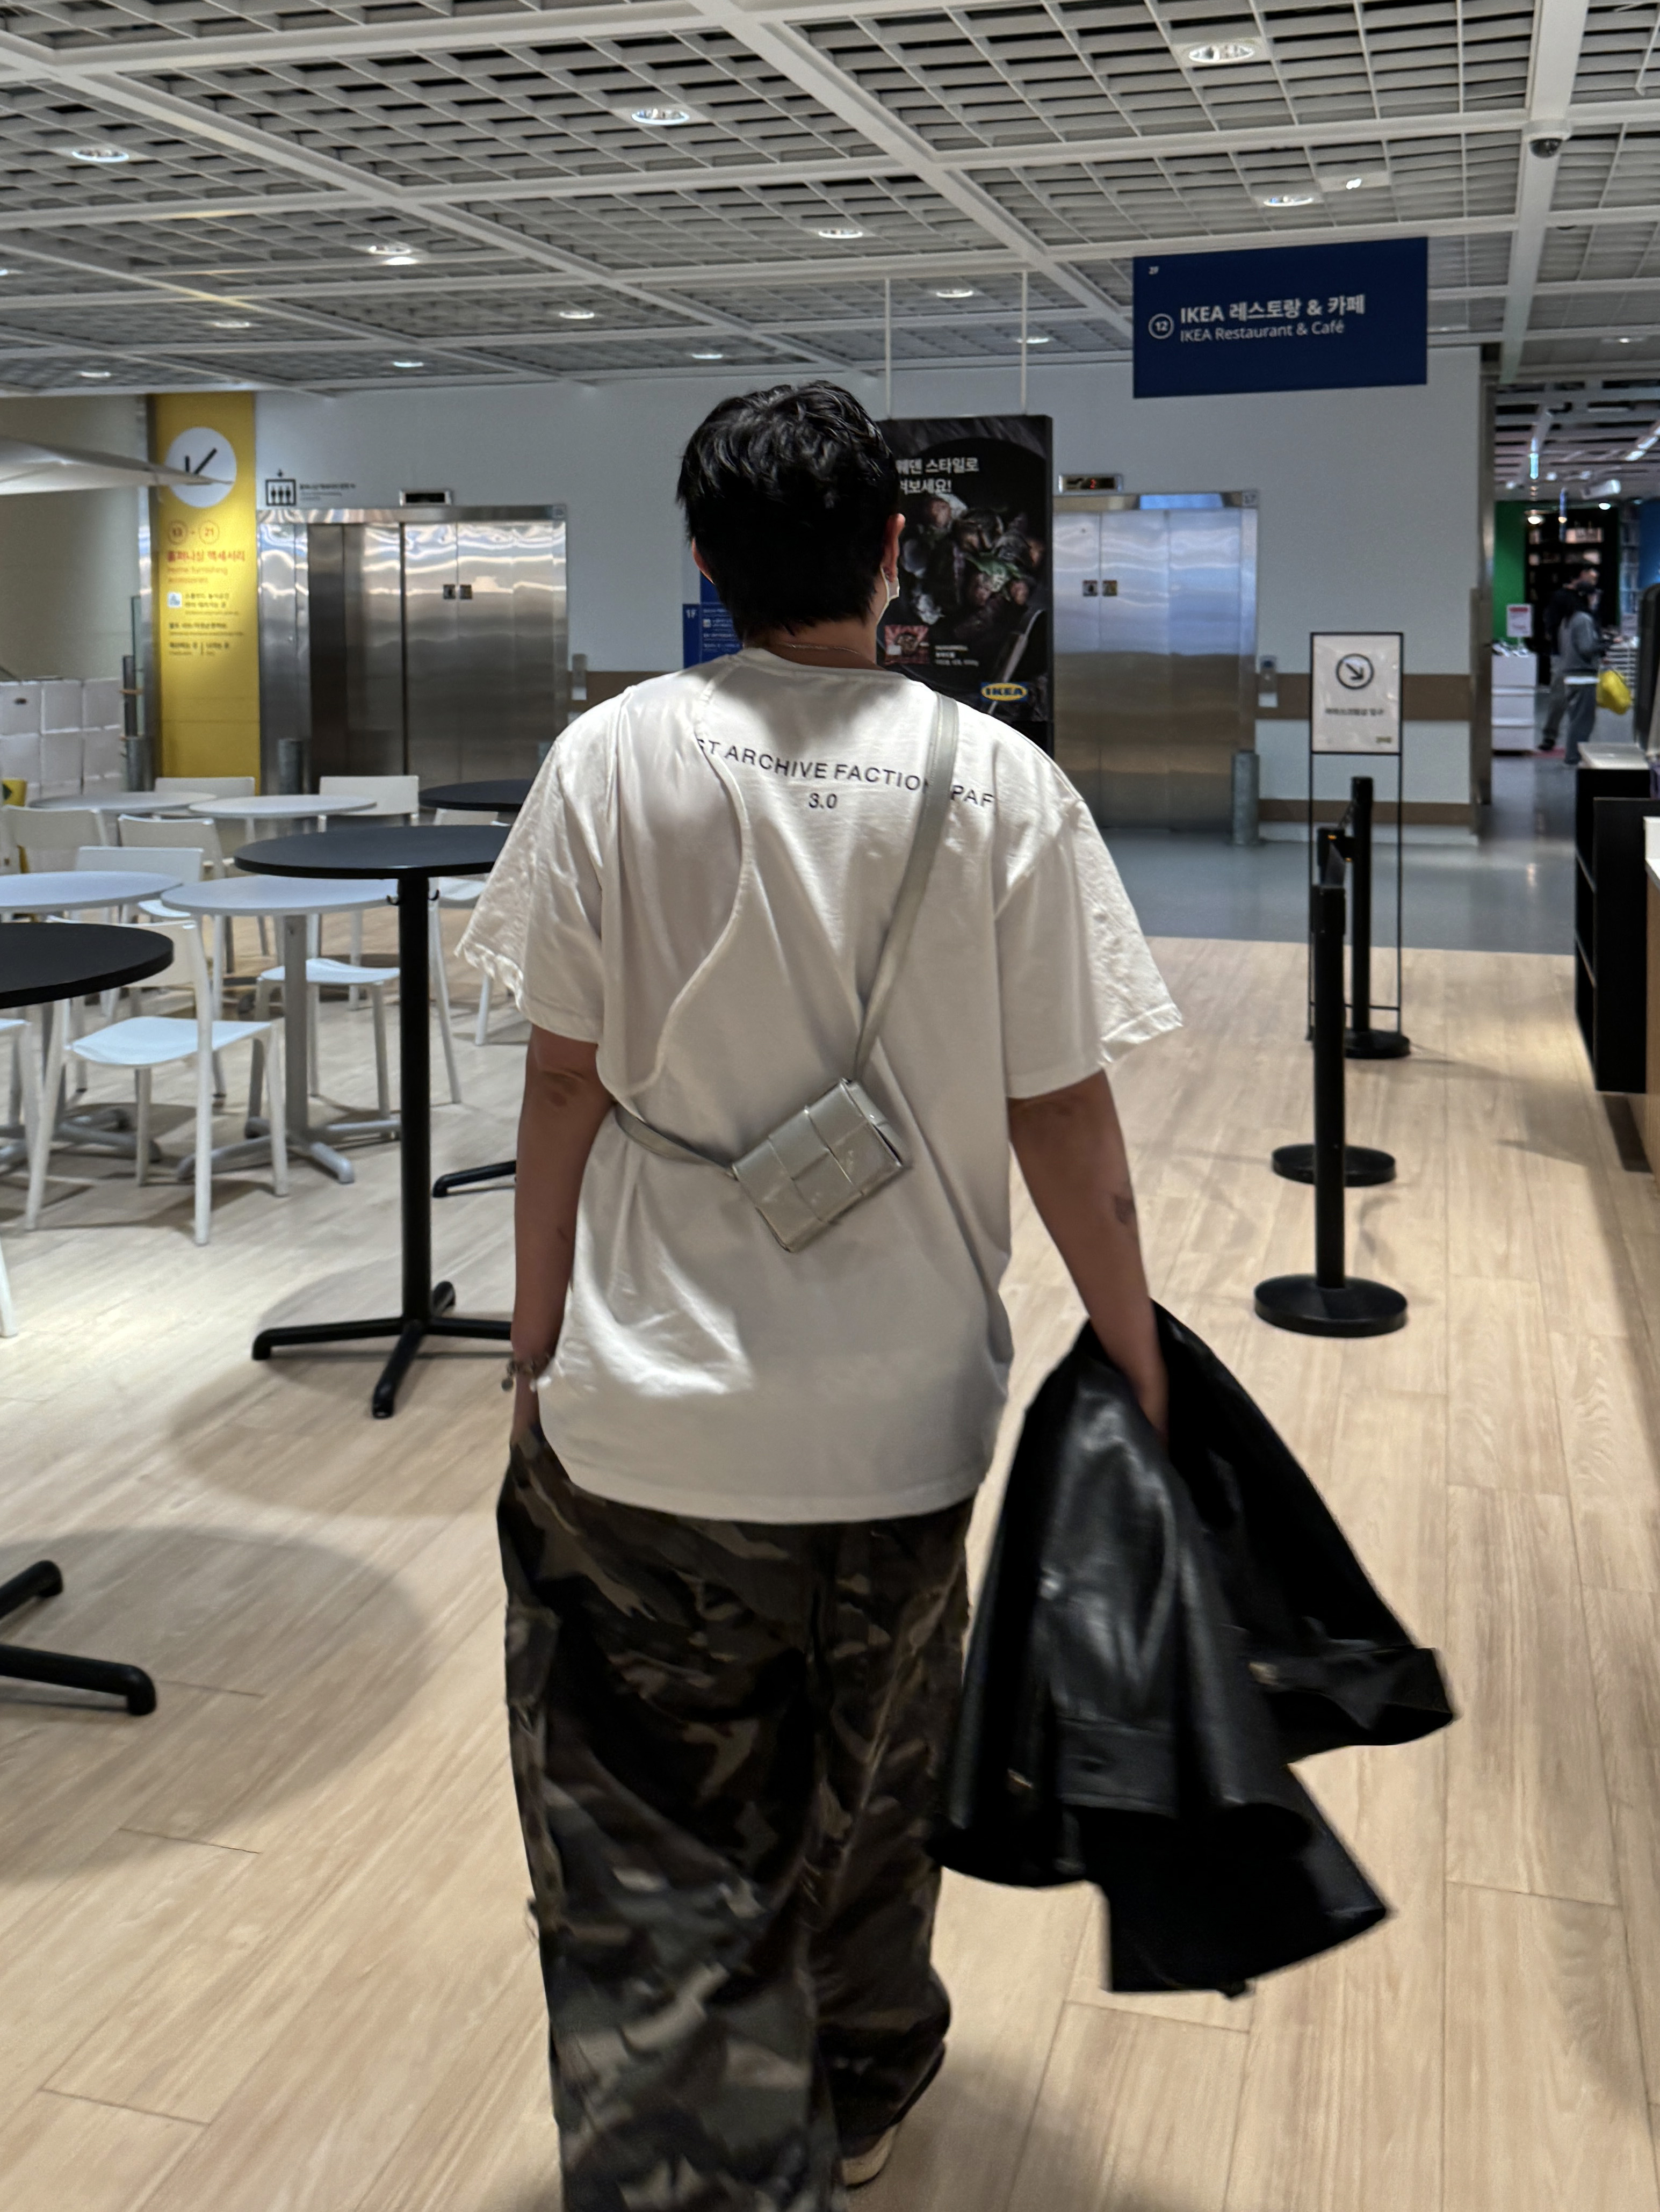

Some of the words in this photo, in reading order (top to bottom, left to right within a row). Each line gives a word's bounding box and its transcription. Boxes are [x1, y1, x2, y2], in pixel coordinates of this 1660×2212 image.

[1180, 305, 1225, 324] IKEA
[1229, 298, 1301, 322] 레스토랑
[1307, 299, 1323, 316] &
[1327, 294, 1365, 316] 카페
[1156, 321, 1168, 331] 12
[1180, 328, 1212, 342] IKEA
[1215, 325, 1293, 340] Restaurant
[1296, 322, 1308, 336] &
[1311, 319, 1345, 335] Café
[925, 457, 979, 474] 스타일로
[986, 688, 1023, 696] IKEA
[725, 745, 828, 779] ARCHIVE
[809, 793, 837, 809] 3.0
